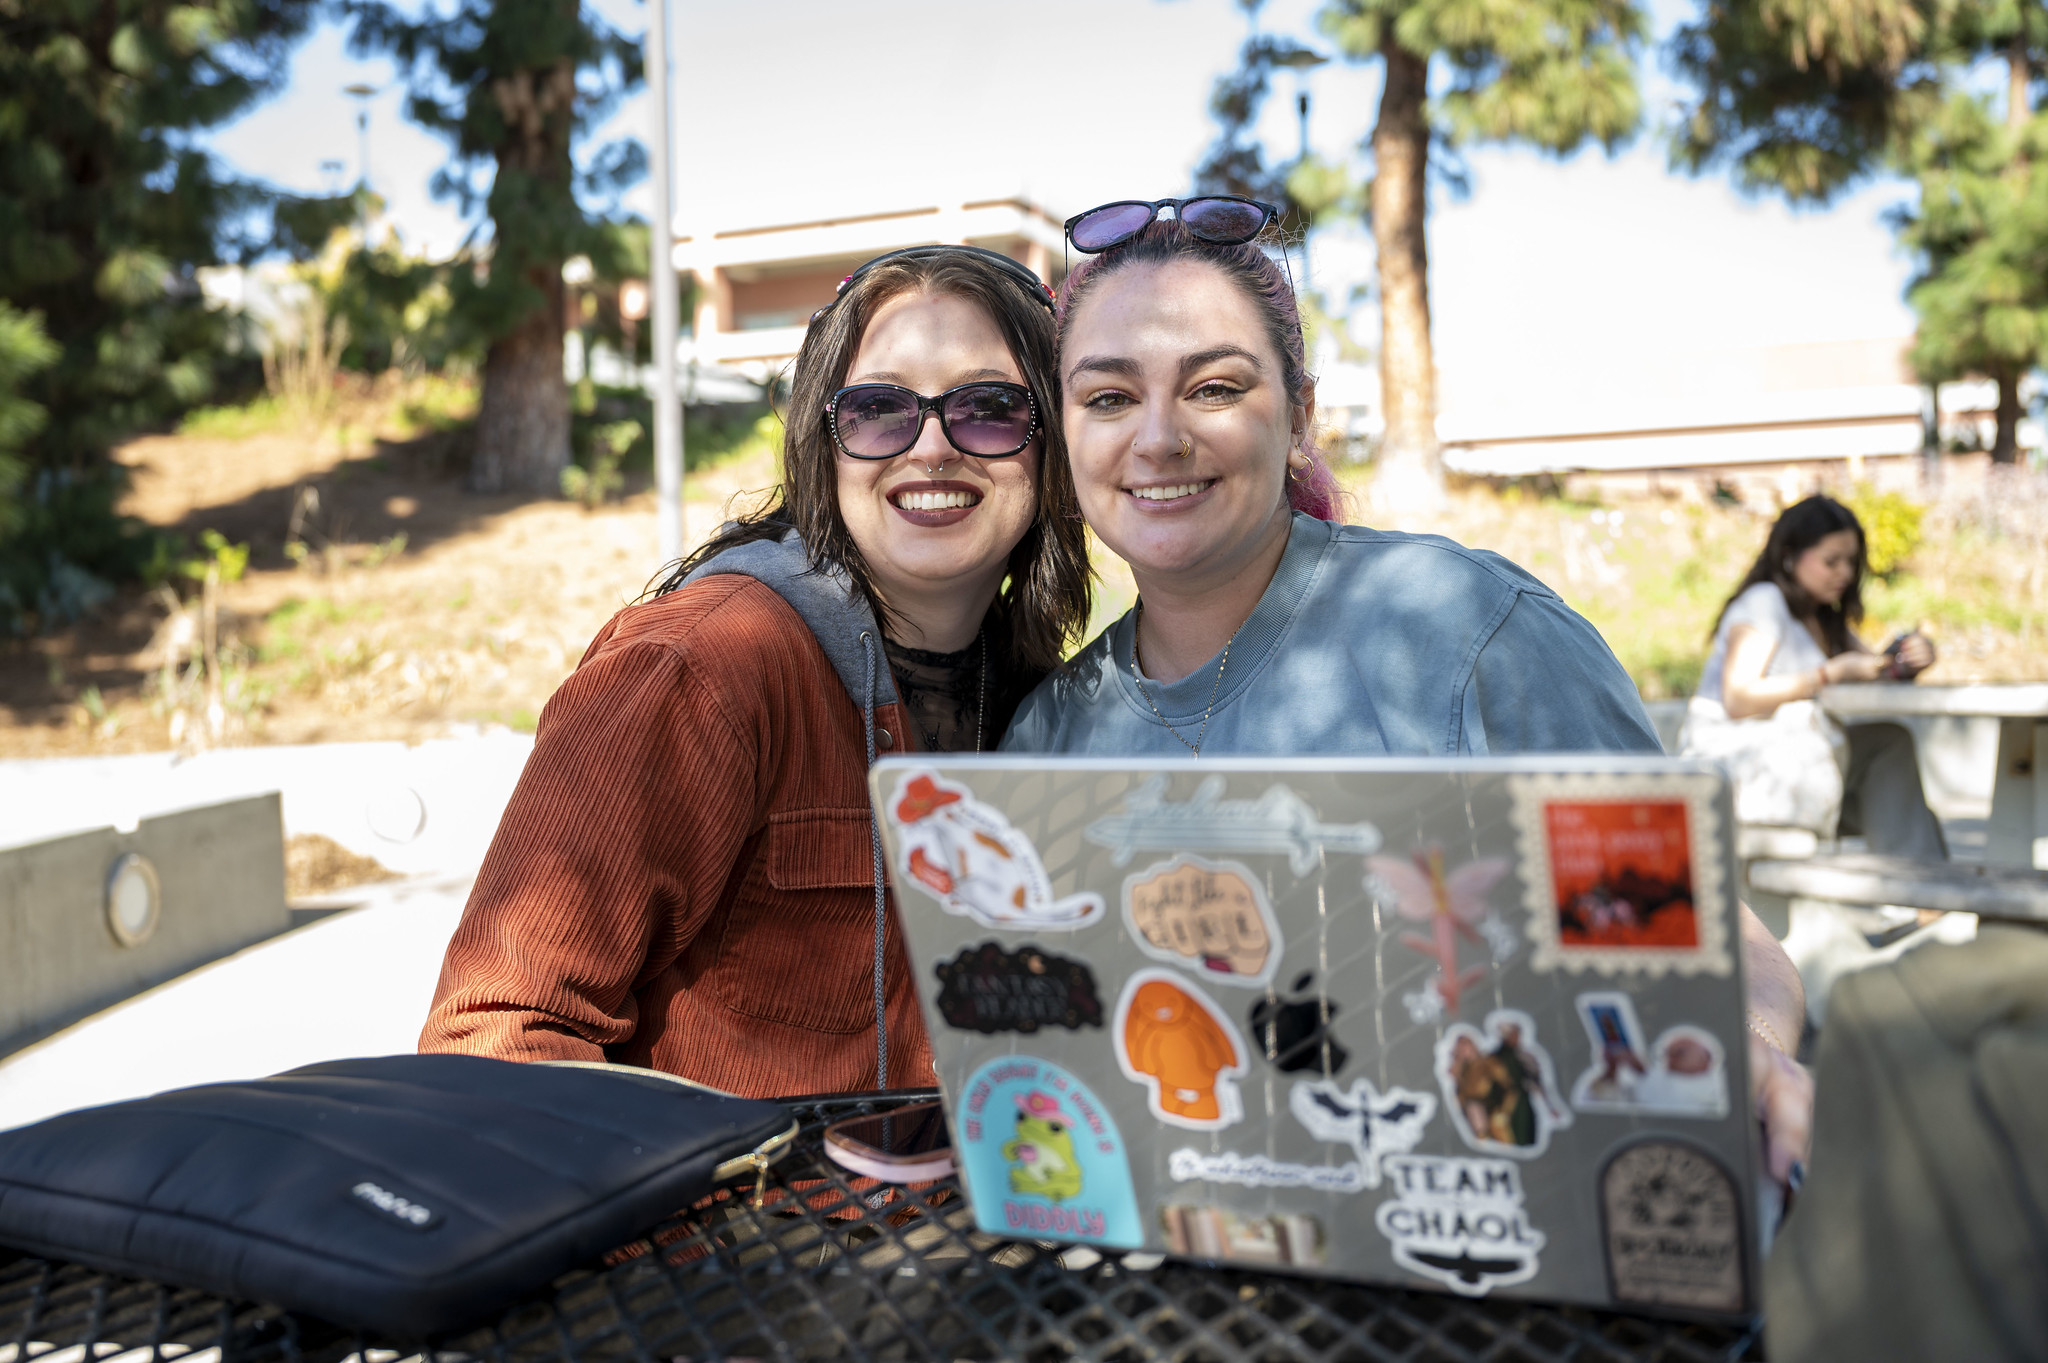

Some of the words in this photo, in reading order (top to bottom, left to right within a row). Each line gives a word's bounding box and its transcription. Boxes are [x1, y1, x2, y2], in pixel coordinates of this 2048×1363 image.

[1396, 1163, 1515, 1197] TEAM
[1004, 1202, 1106, 1237] DIDDLY
[1386, 1208, 1537, 1245] CHAOL
